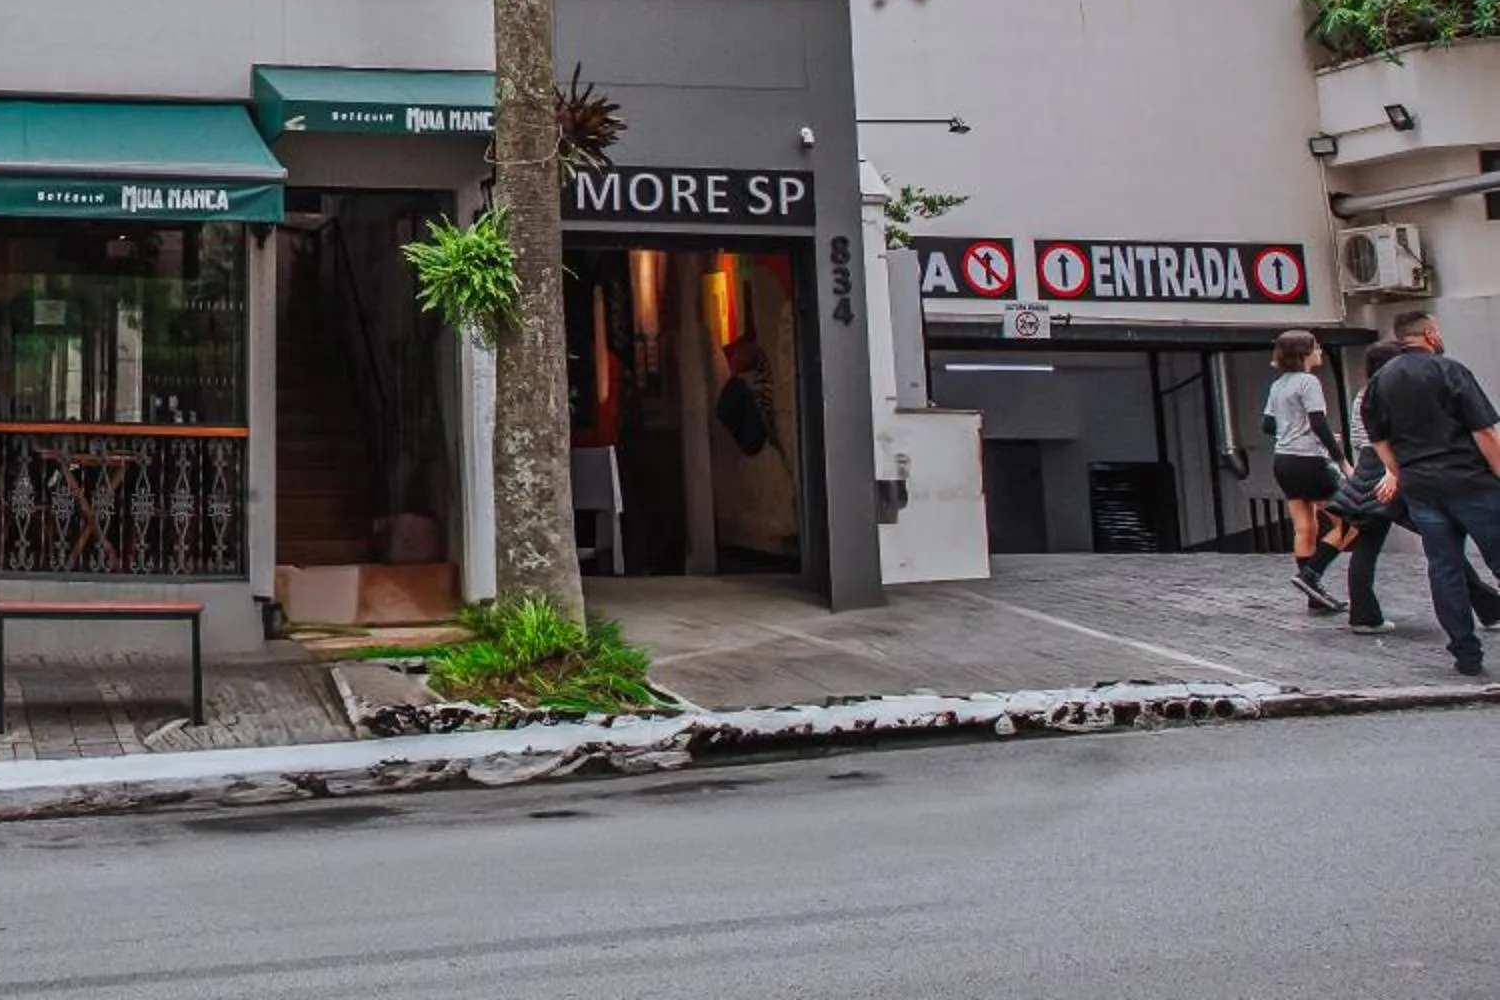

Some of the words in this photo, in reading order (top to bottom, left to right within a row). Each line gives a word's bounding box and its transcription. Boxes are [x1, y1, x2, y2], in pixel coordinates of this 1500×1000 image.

[449, 110, 495, 131] MANC
[167, 188, 229, 211] MANCA
[576, 171, 730, 214] MORE
[747, 175, 806, 216] SP
[829, 235, 855, 327] 834
[1091, 245, 1250, 299] ENTRADA
